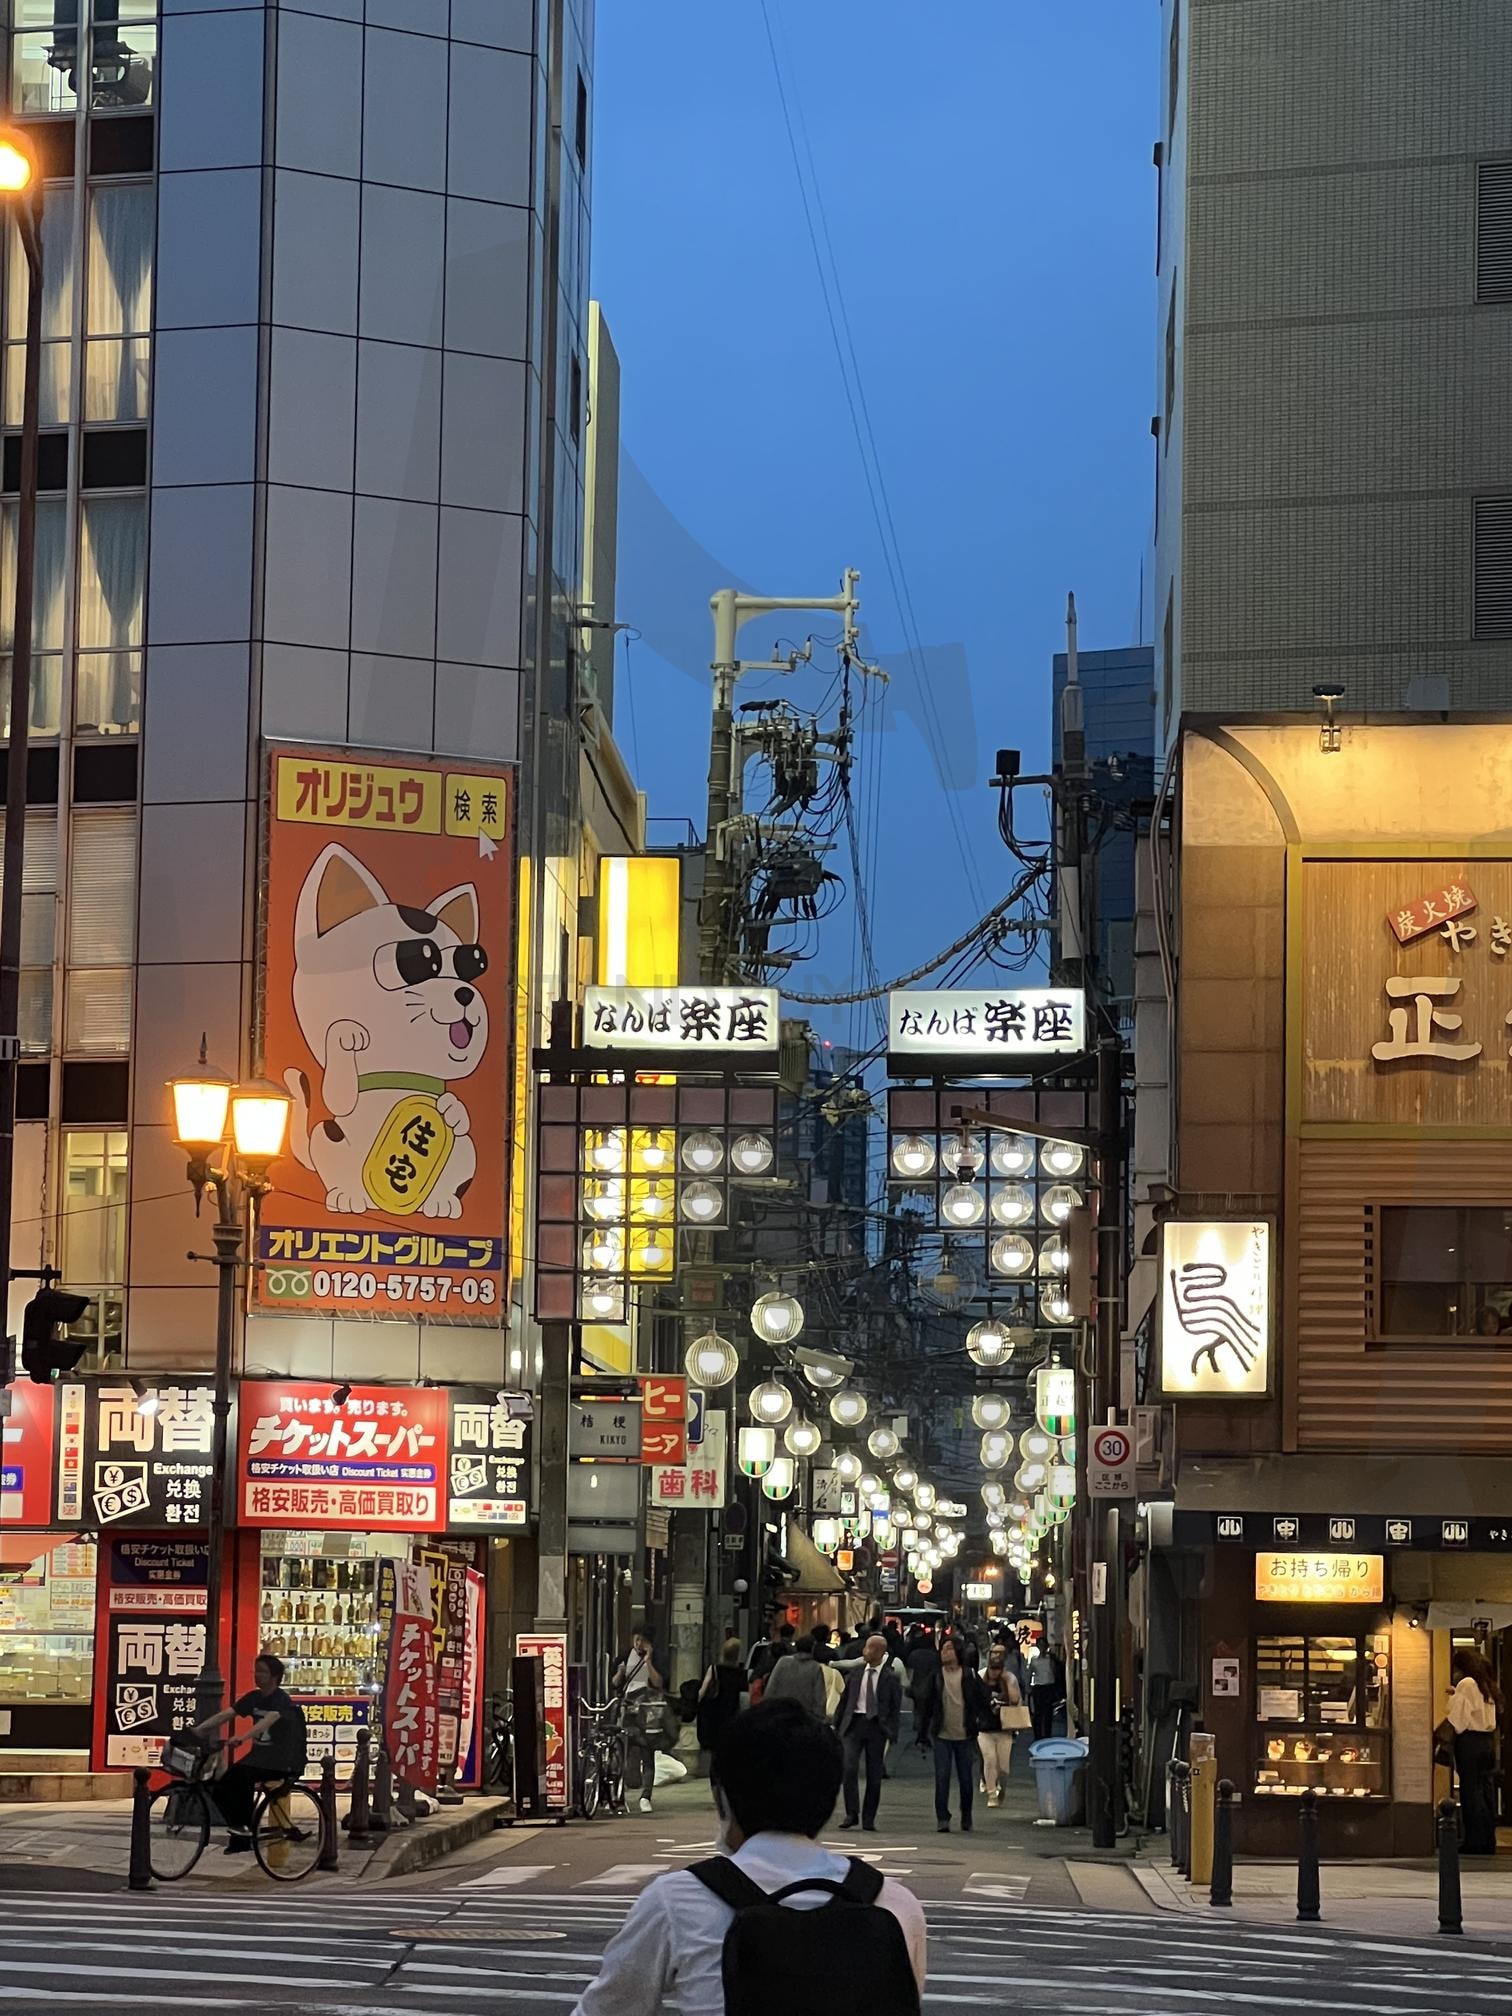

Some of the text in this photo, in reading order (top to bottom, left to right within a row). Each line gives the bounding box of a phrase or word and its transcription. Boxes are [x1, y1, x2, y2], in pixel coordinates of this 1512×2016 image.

[296, 767, 498, 825] オリジュウ 検索
[1396, 884, 1473, 938] 炭火焼
[593, 996, 771, 1042] なんば楽座
[899, 999, 1074, 1042] なんば楽座
[1371, 976, 1511, 1061] 正
[385, 1115, 436, 1193] 住宅
[269, 1229, 493, 1268] オリエントグループ
[312, 1270, 496, 1305] 0120-5757-03
[98, 1386, 216, 1453] 両替
[248, 1414, 436, 1458] チケットスーパー
[454, 1403, 528, 1449] 両替
[1102, 1440, 1122, 1456] 30
[153, 1462, 214, 1478] Exchange
[658, 1468, 719, 1499] 歯科
[1094, 1481, 1129, 1491] ここから
[165, 1503, 200, 1523] 환전
[251, 1486, 430, 1517] 格安販売・高価買取り
[1270, 1558, 1369, 1578] お持ち帰り
[118, 1623, 207, 1676] 両替
[392, 1623, 422, 1776] チケットスーパー
